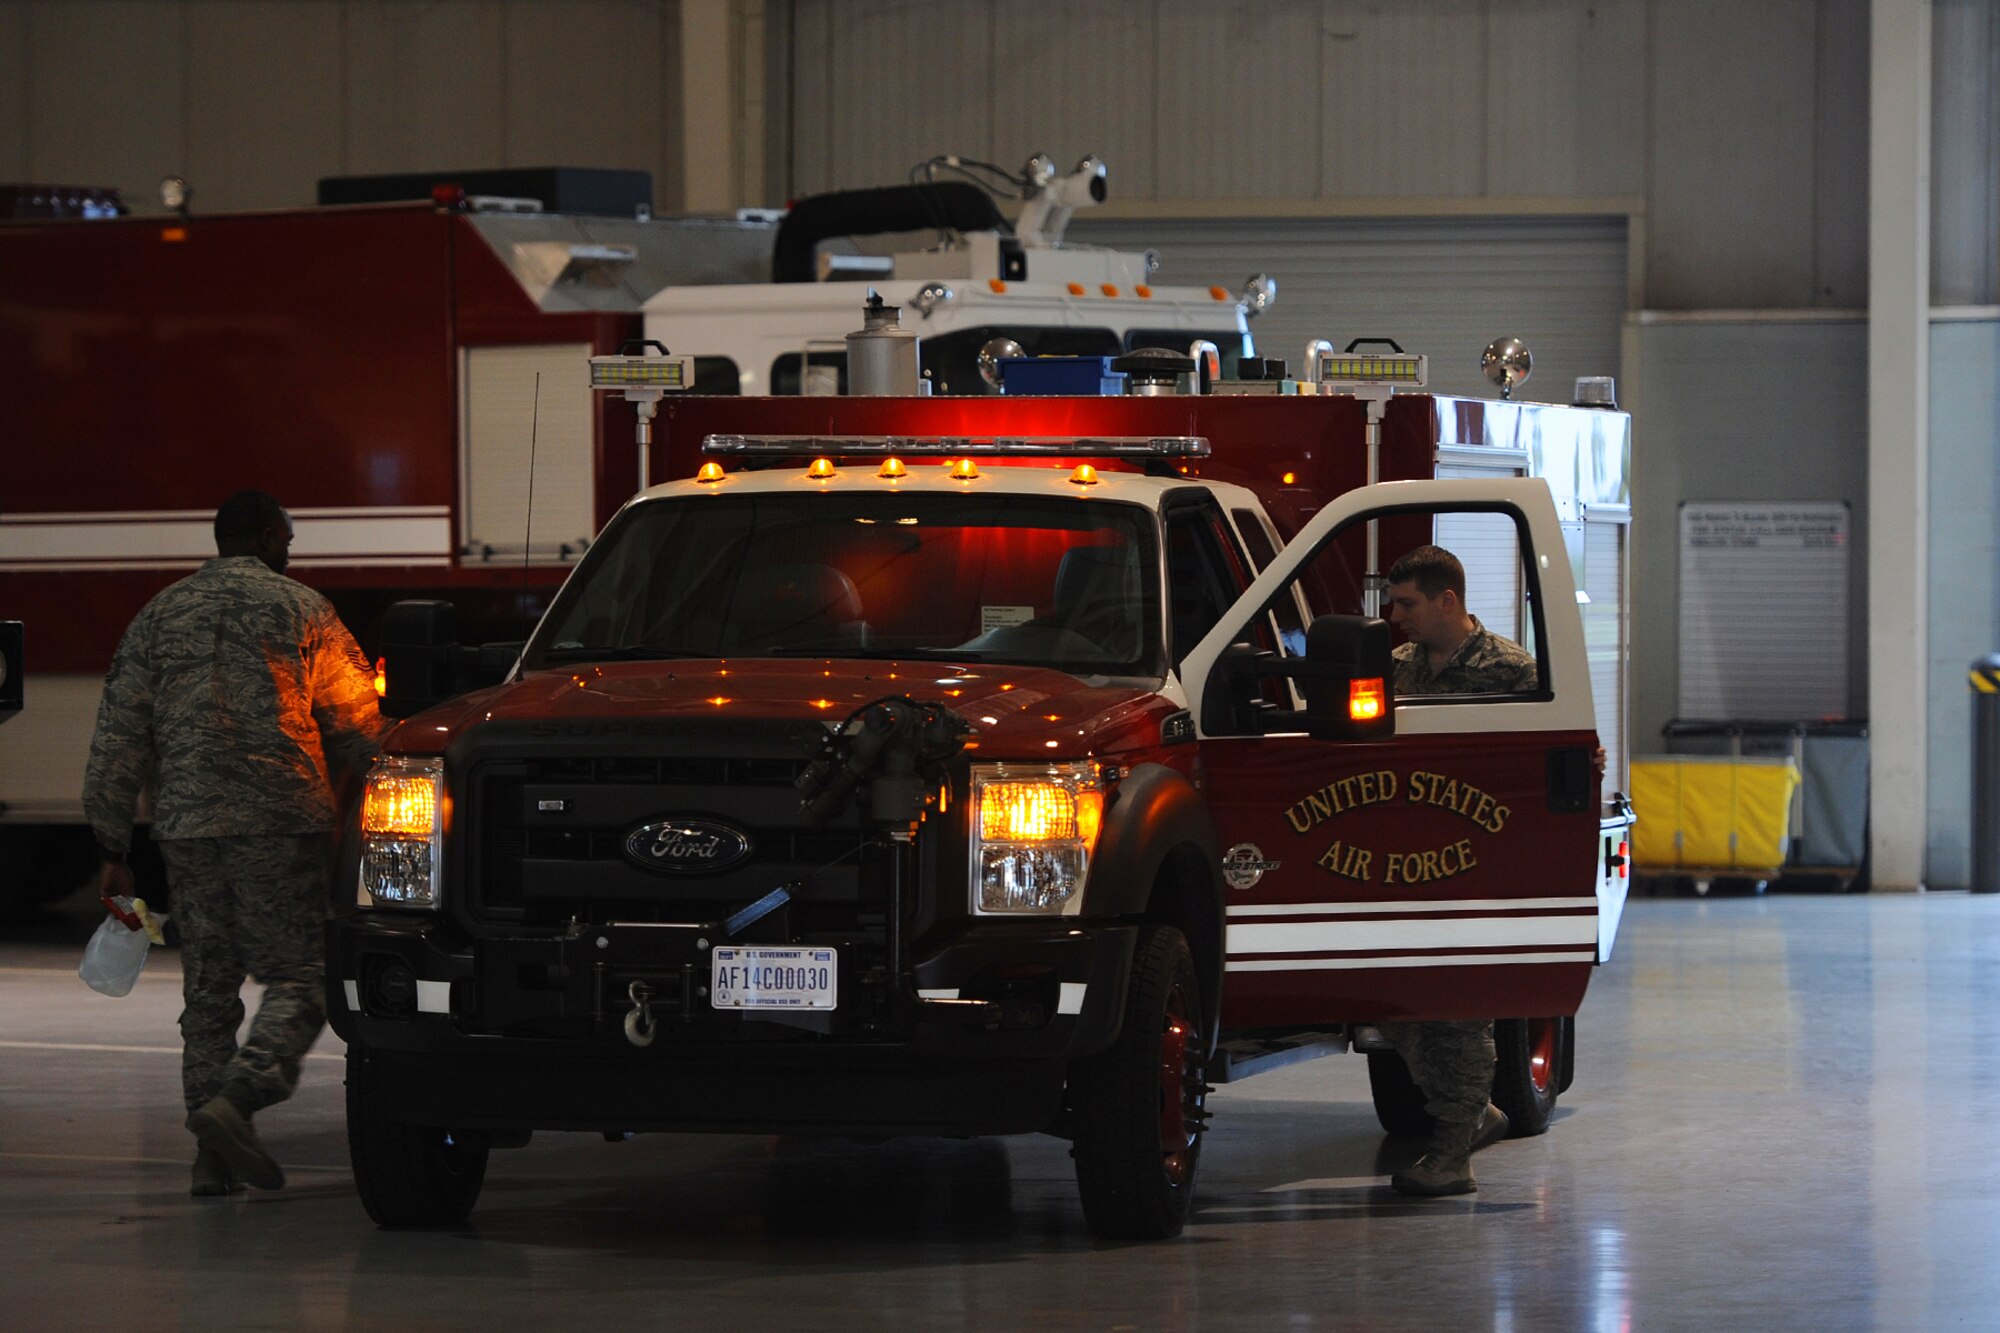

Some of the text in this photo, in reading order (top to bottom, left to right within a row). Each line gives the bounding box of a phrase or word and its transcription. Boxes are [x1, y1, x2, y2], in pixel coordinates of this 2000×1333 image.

[1284, 770, 1511, 834] UNITED STATES
[651, 823, 720, 858] Ford
[1317, 838, 1478, 884] AIR FORCE
[759, 951, 802, 959] GOVERNMENT
